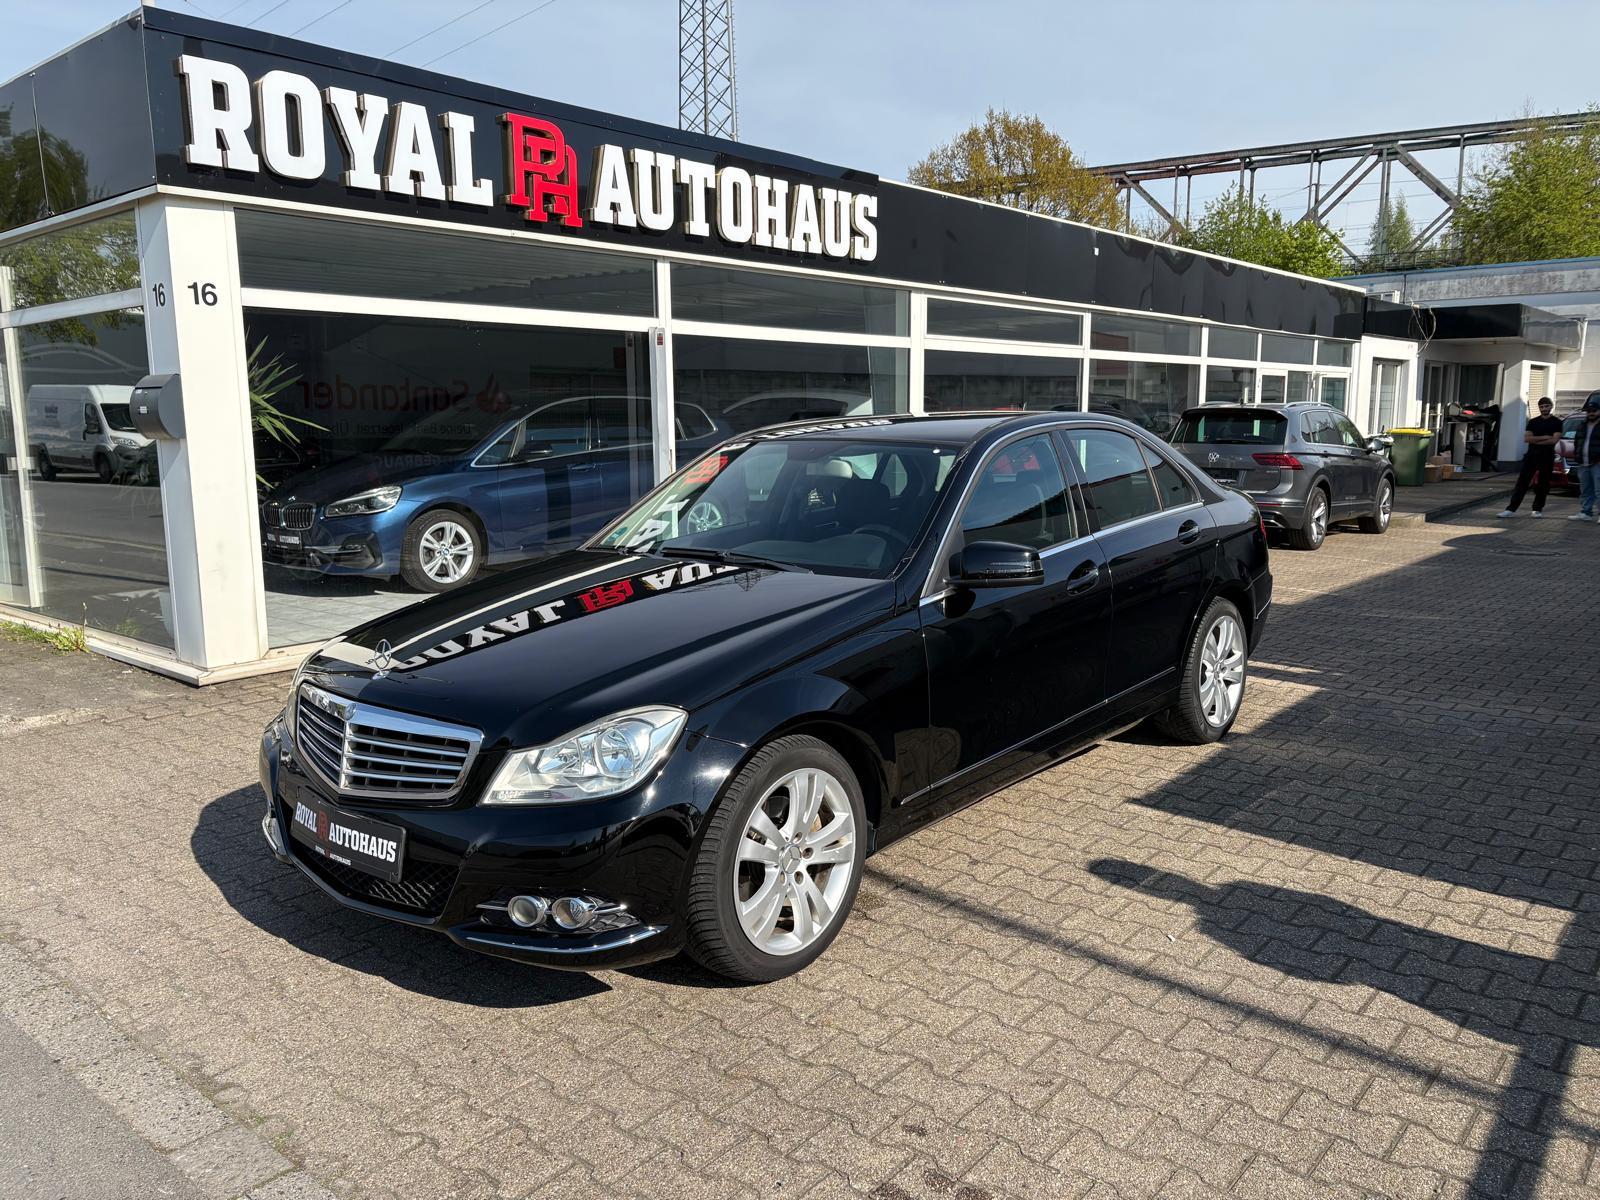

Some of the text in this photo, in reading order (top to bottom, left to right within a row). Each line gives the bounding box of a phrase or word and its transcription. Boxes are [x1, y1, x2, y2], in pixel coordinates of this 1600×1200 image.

[178, 54, 494, 207] ROYAL
[588, 144, 878, 262] AUTOHAUS
[152, 283, 166, 307] 16
[187, 282, 218, 306] 16
[295, 801, 318, 833] ROYAL
[328, 822, 397, 863] AUTOHAUS
